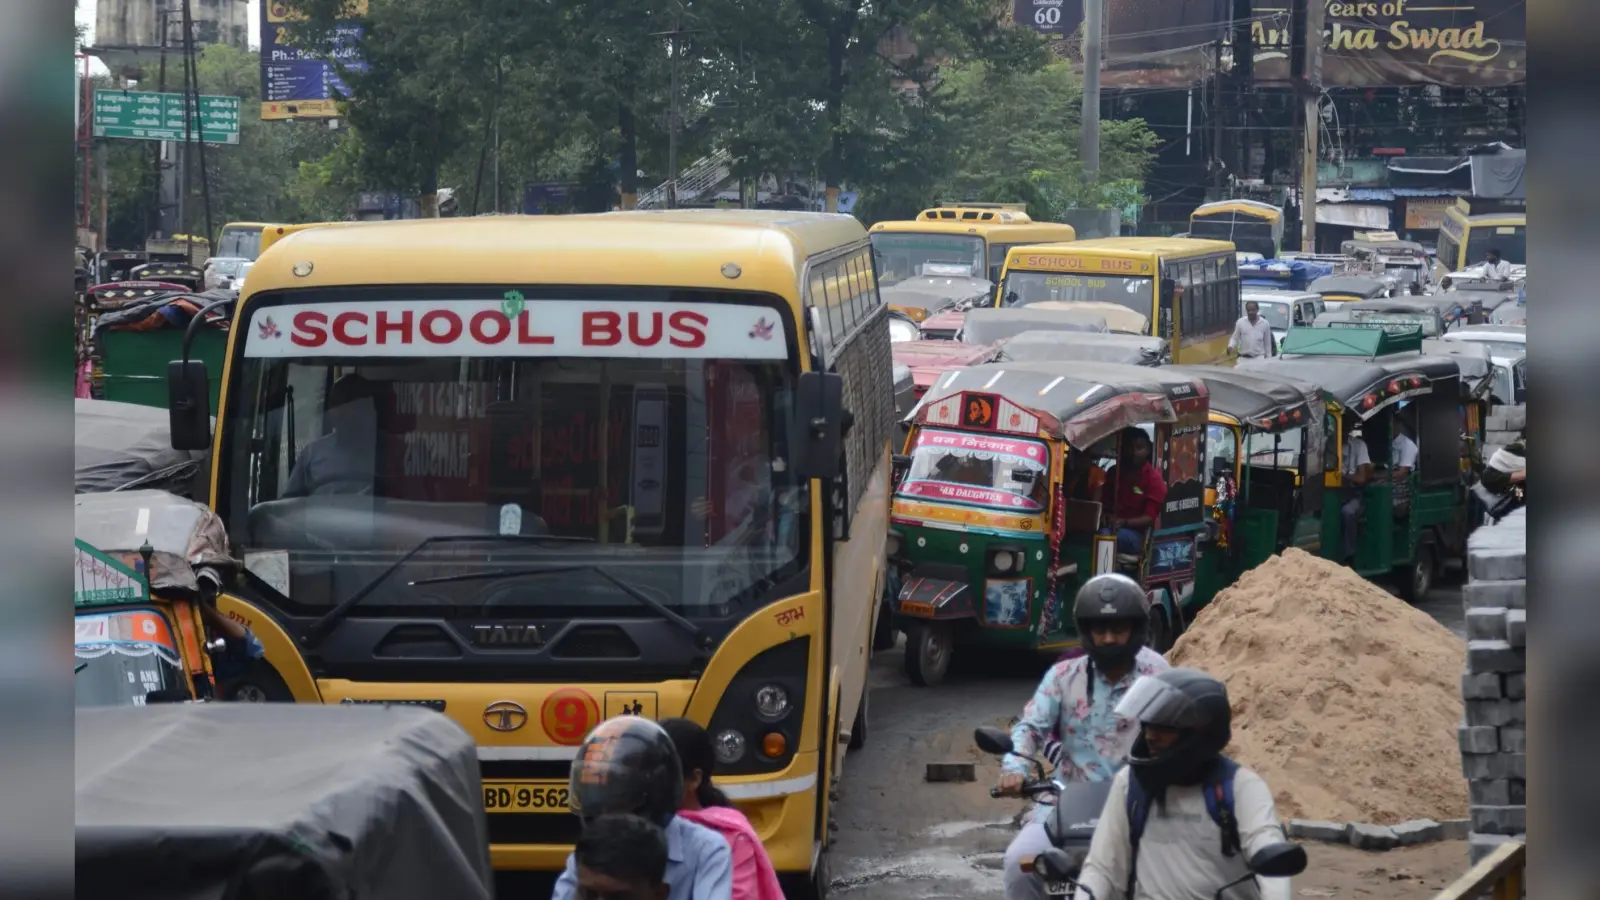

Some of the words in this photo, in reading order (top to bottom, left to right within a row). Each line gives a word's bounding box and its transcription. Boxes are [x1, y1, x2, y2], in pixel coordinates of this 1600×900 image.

[1034, 7, 1061, 24] 60
[1382, 0, 1404, 17] of
[1388, 21, 1499, 52] Swad
[1028, 256, 1087, 269] SCHOOL
[1101, 259, 1133, 271] BUS
[1044, 276, 1082, 288] SCHOOL
[1087, 279, 1106, 288] BUS
[290, 309, 555, 348] SCHOOL
[581, 310, 709, 349] BUS
[955, 488, 1003, 502] DAUGHTER
[773, 604, 805, 627] लाभ
[474, 625, 541, 643] TATA
[555, 697, 588, 738] 9
[484, 788, 511, 808] BD
[517, 788, 570, 808] 9562
